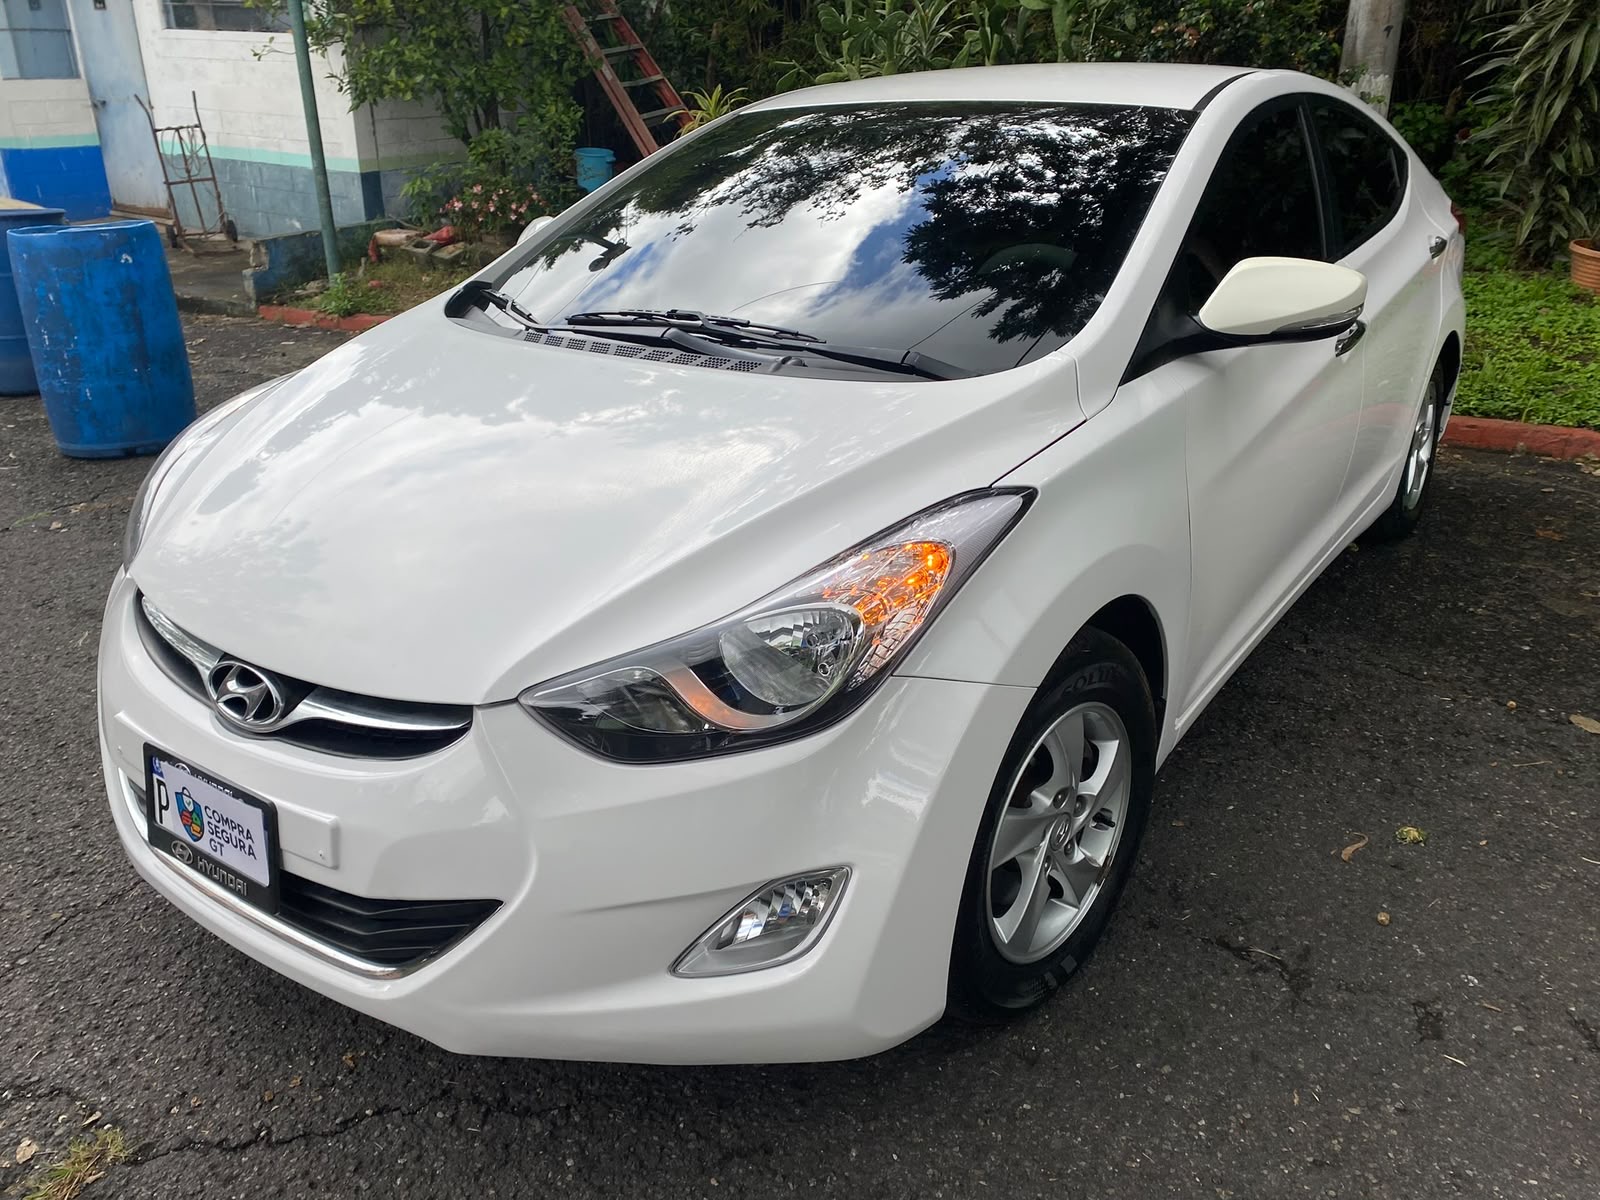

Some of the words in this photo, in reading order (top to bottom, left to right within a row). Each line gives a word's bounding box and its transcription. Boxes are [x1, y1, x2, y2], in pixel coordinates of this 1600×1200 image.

[156, 780, 170, 825] P
[204, 805, 255, 844] COMPRA
[207, 821, 257, 860] SEGURA
[209, 838, 225, 857] GT
[197, 856, 248, 897] HYUNDAI
